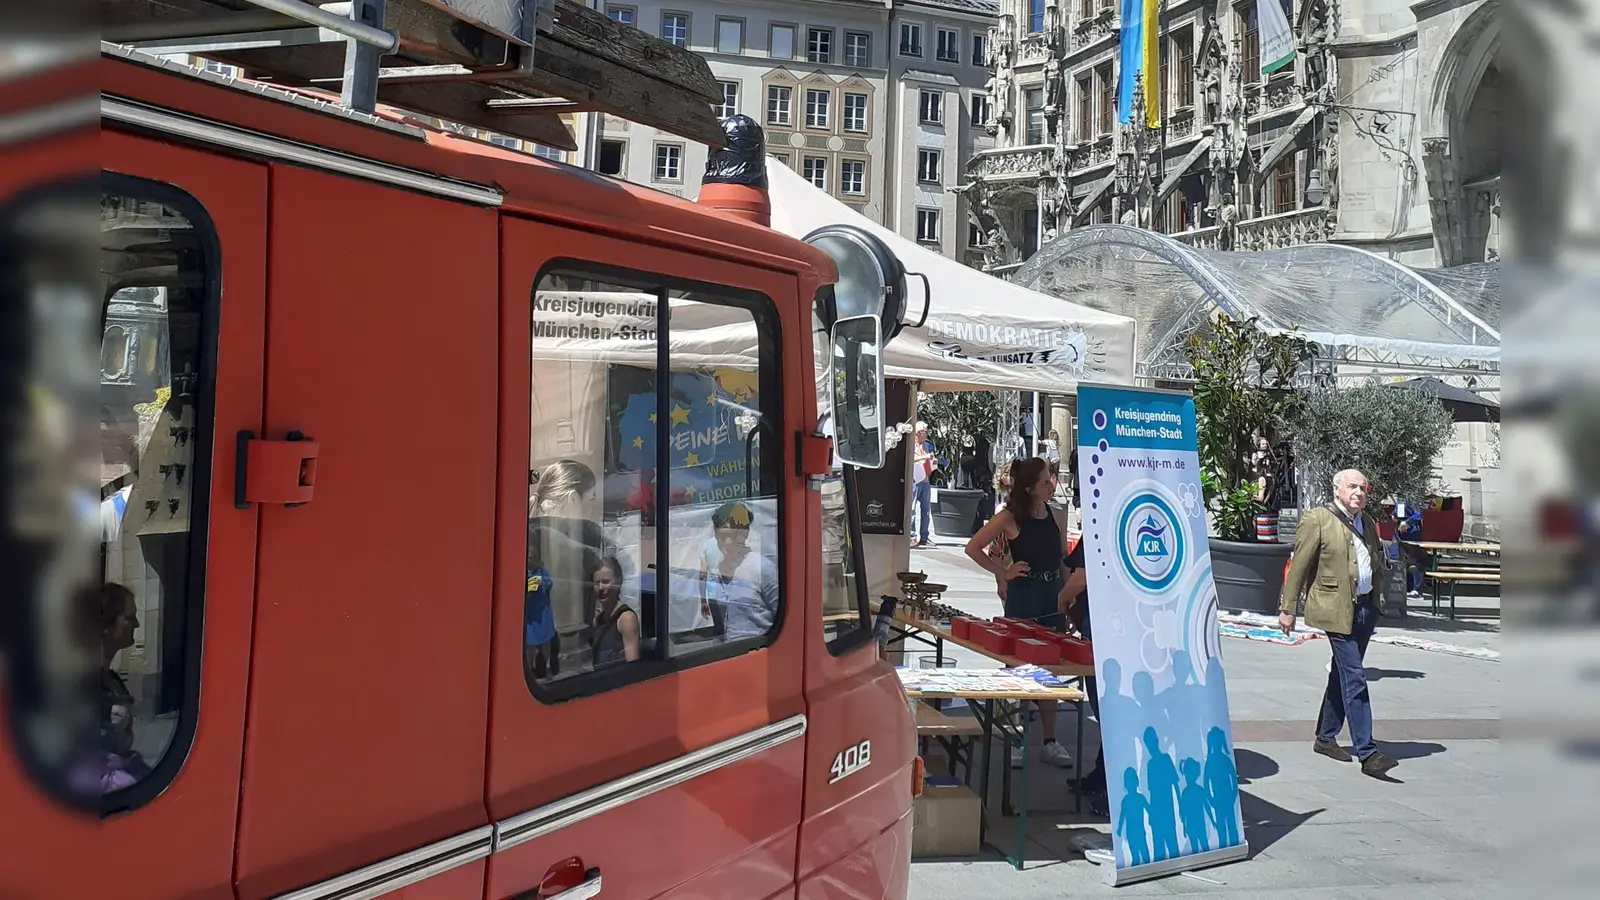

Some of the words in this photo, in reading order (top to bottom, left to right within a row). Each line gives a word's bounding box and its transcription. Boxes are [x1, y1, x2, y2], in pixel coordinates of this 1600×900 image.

[533, 294, 671, 320] Kreisjugendri
[533, 320, 659, 341] München-Stad
[926, 318, 1064, 348] DEMOKRATIE
[997, 352, 1034, 364] EINSATZ
[1114, 407, 1182, 425] Kreisjugendring
[1115, 424, 1183, 439] München-Stadt
[706, 456, 760, 477] WÄHLN
[1117, 457, 1186, 471] www.kjr-m.de
[1143, 540, 1161, 553] KJR
[830, 739, 871, 778] 408
